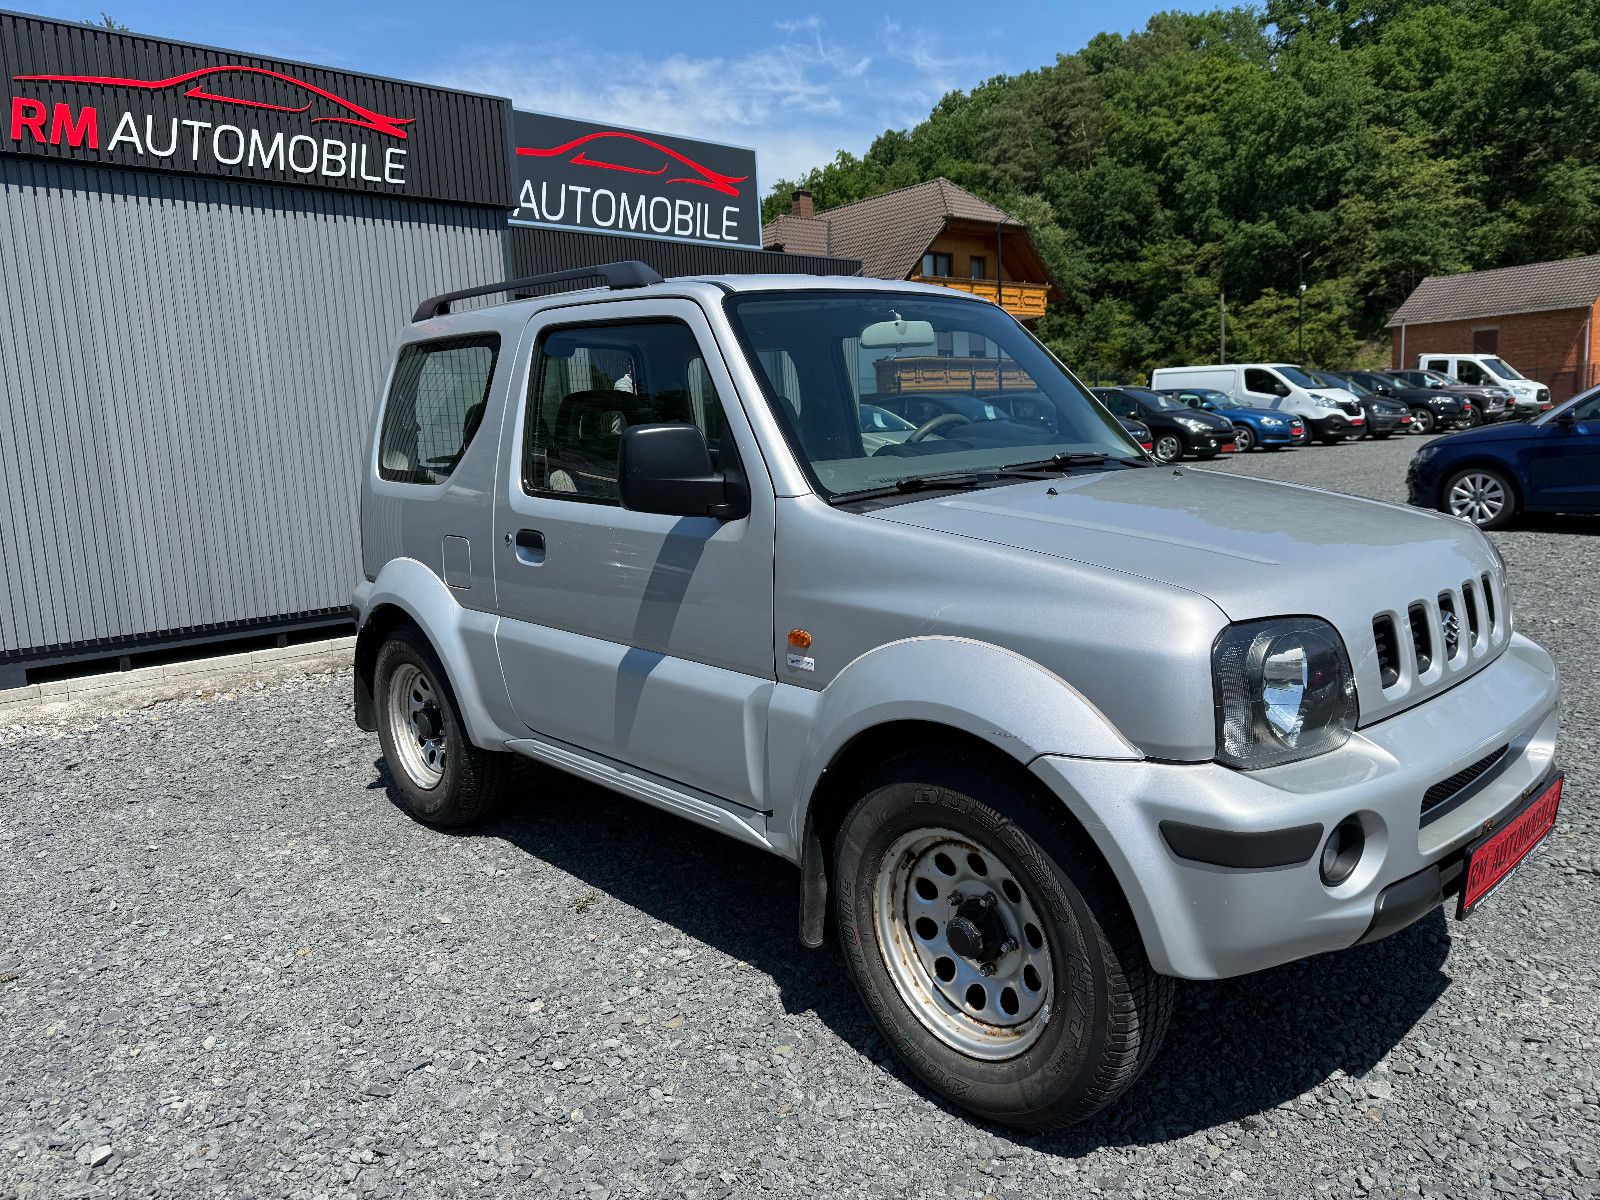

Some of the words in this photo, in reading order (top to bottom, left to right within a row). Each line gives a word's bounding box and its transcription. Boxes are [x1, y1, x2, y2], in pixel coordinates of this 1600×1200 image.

[10, 97, 99, 149] RM
[107, 111, 407, 184] AUTOMOBILE
[512, 179, 740, 241] AUTOMOBILE
[1469, 852, 1489, 891] RM
[1492, 791, 1558, 875] AUTOMOBILE
